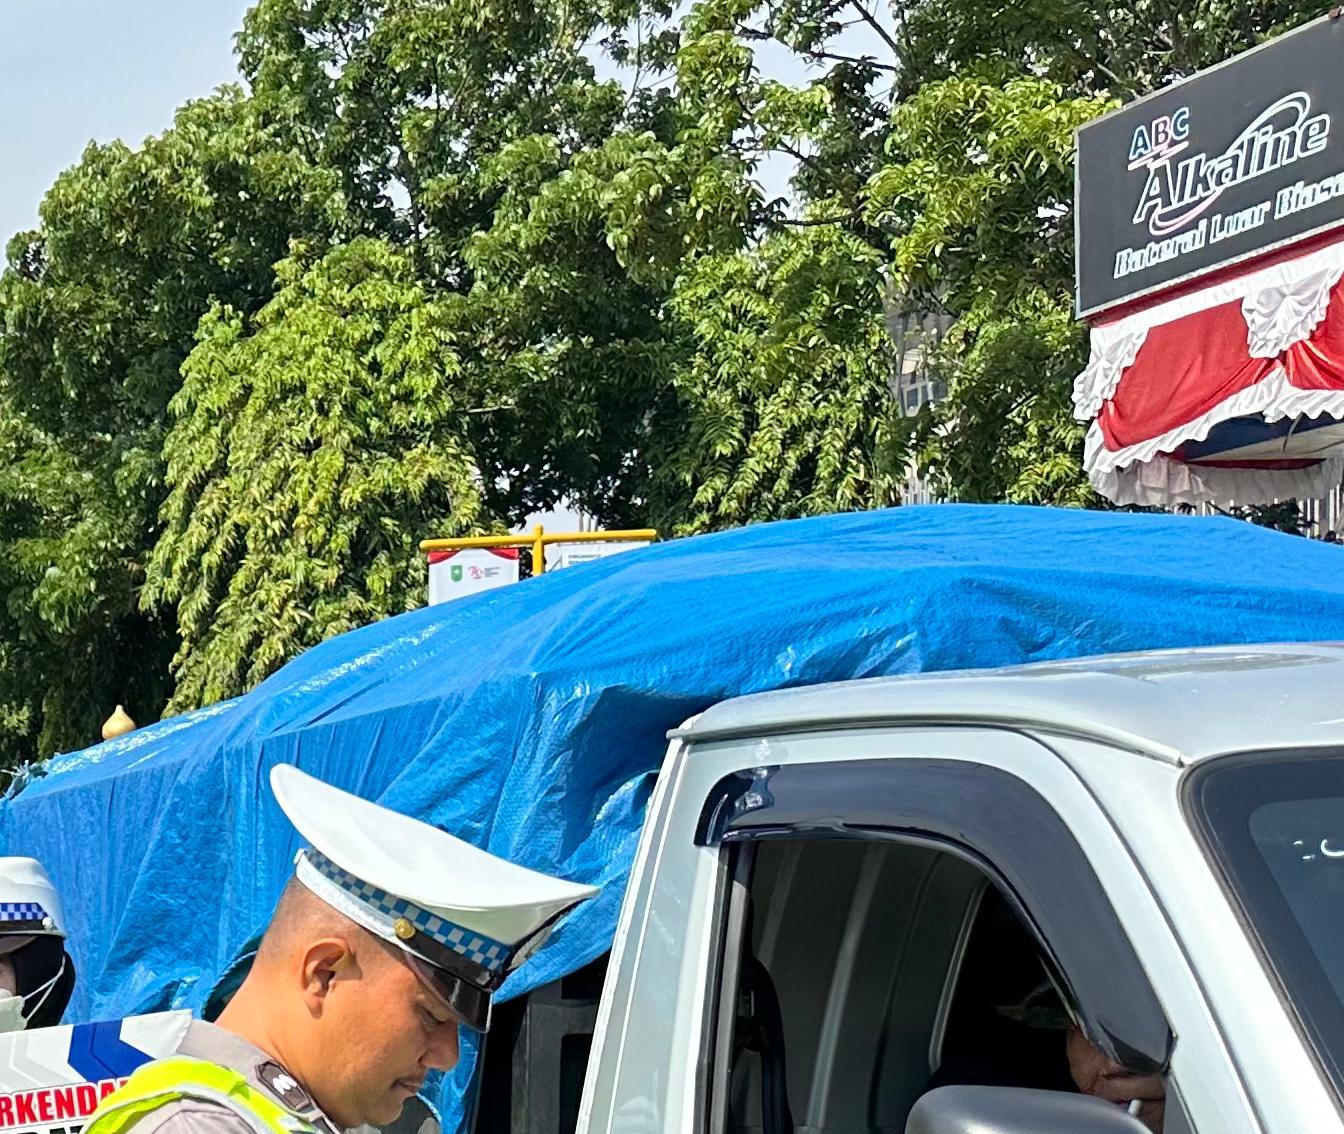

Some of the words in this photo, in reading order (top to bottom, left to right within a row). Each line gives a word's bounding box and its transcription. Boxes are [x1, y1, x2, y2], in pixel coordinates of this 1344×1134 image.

[1129, 107, 1189, 159] ABC
[1133, 114, 1330, 223] Alkaline
[1210, 201, 1272, 244] Luar
